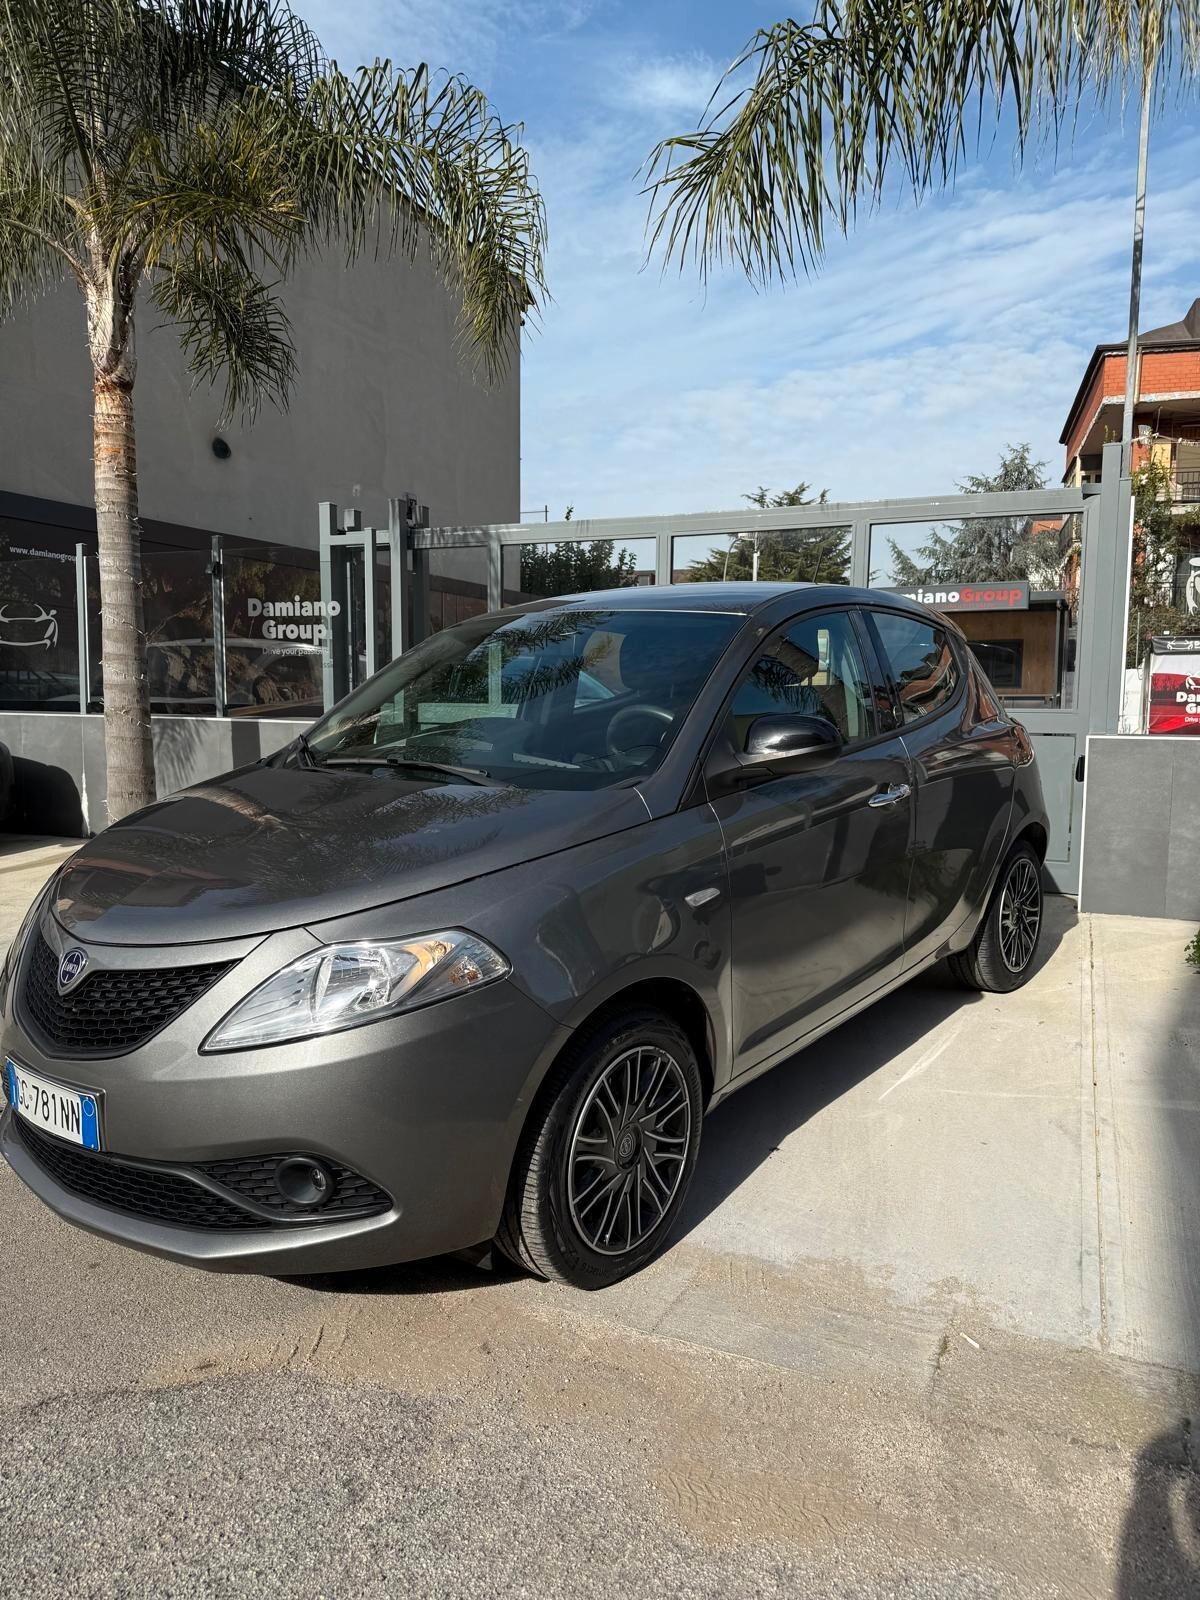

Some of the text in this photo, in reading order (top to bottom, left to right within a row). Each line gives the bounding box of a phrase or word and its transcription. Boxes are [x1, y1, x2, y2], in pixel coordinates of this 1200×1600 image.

[9, 546, 77, 563] www.damianogrou
[247, 594, 341, 617] Damiano
[262, 619, 328, 646] Group
[281, 648, 297, 657] your
[1176, 691, 1200, 703] Da
[32, 1084, 80, 1135] 781NN
